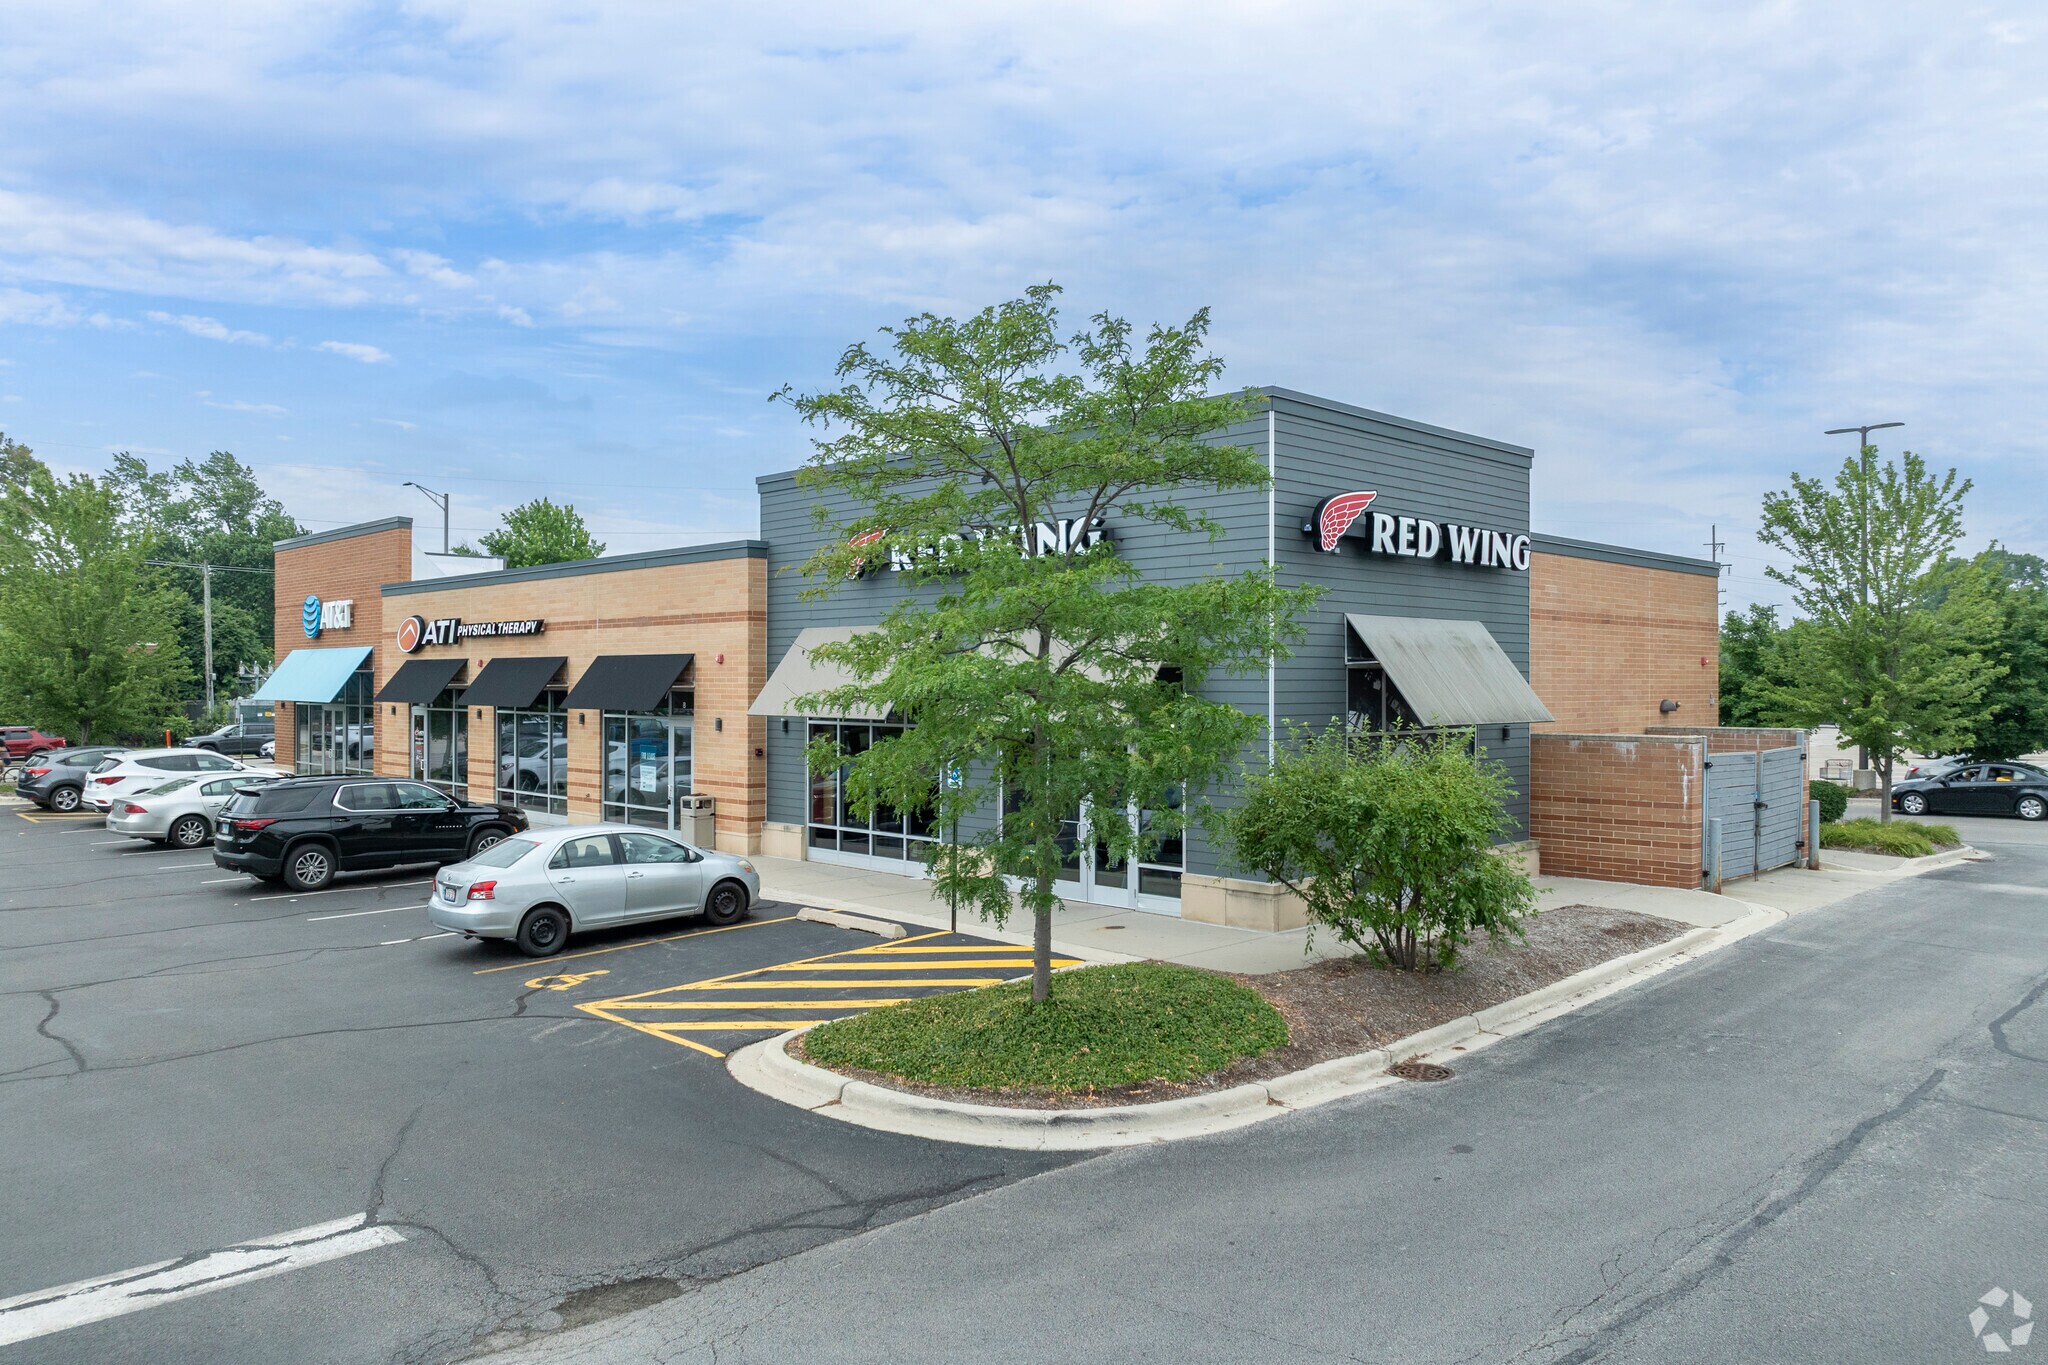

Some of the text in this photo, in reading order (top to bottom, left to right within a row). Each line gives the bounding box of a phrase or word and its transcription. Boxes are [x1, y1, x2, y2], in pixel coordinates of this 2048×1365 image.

[1371, 512, 1531, 571] RED WING
[319, 599, 354, 630] AT&T
[421, 619, 538, 645] ATI PHYSICAL THERAPY
